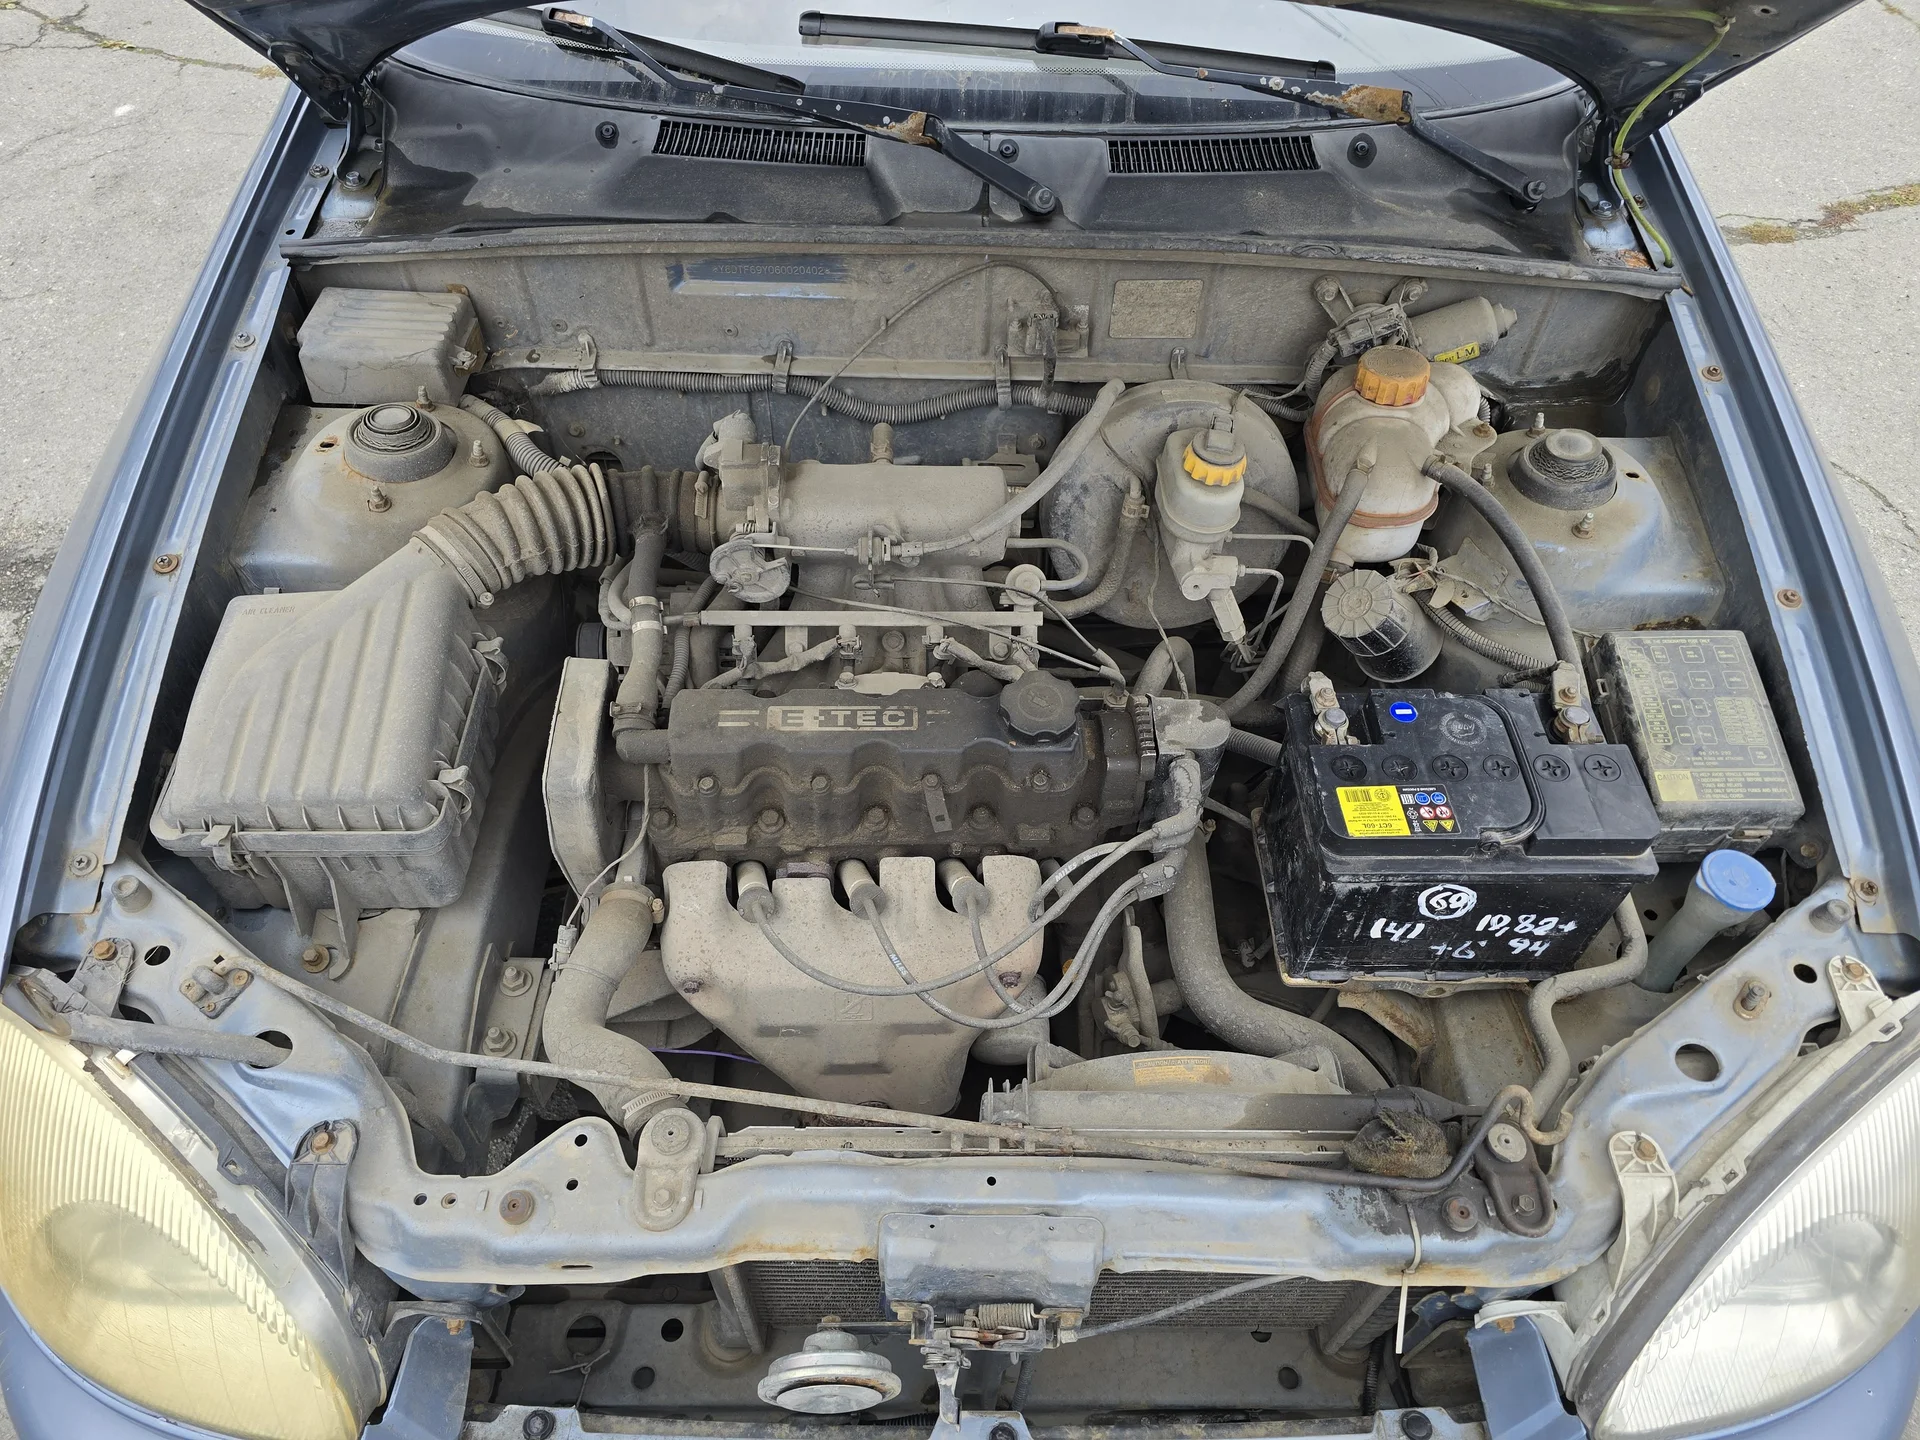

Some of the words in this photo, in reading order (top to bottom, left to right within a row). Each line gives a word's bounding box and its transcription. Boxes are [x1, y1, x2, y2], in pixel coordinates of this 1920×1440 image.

[241, 608, 256, 616] AIR
[259, 606, 296, 615] CLEANER
[781, 709, 906, 728] E-TEC
[1656, 773, 1689, 781] CAUTION
[1054, 861, 1078, 883] MILES
[1508, 938, 1552, 957] 94
[889, 953, 909, 976] MILES
